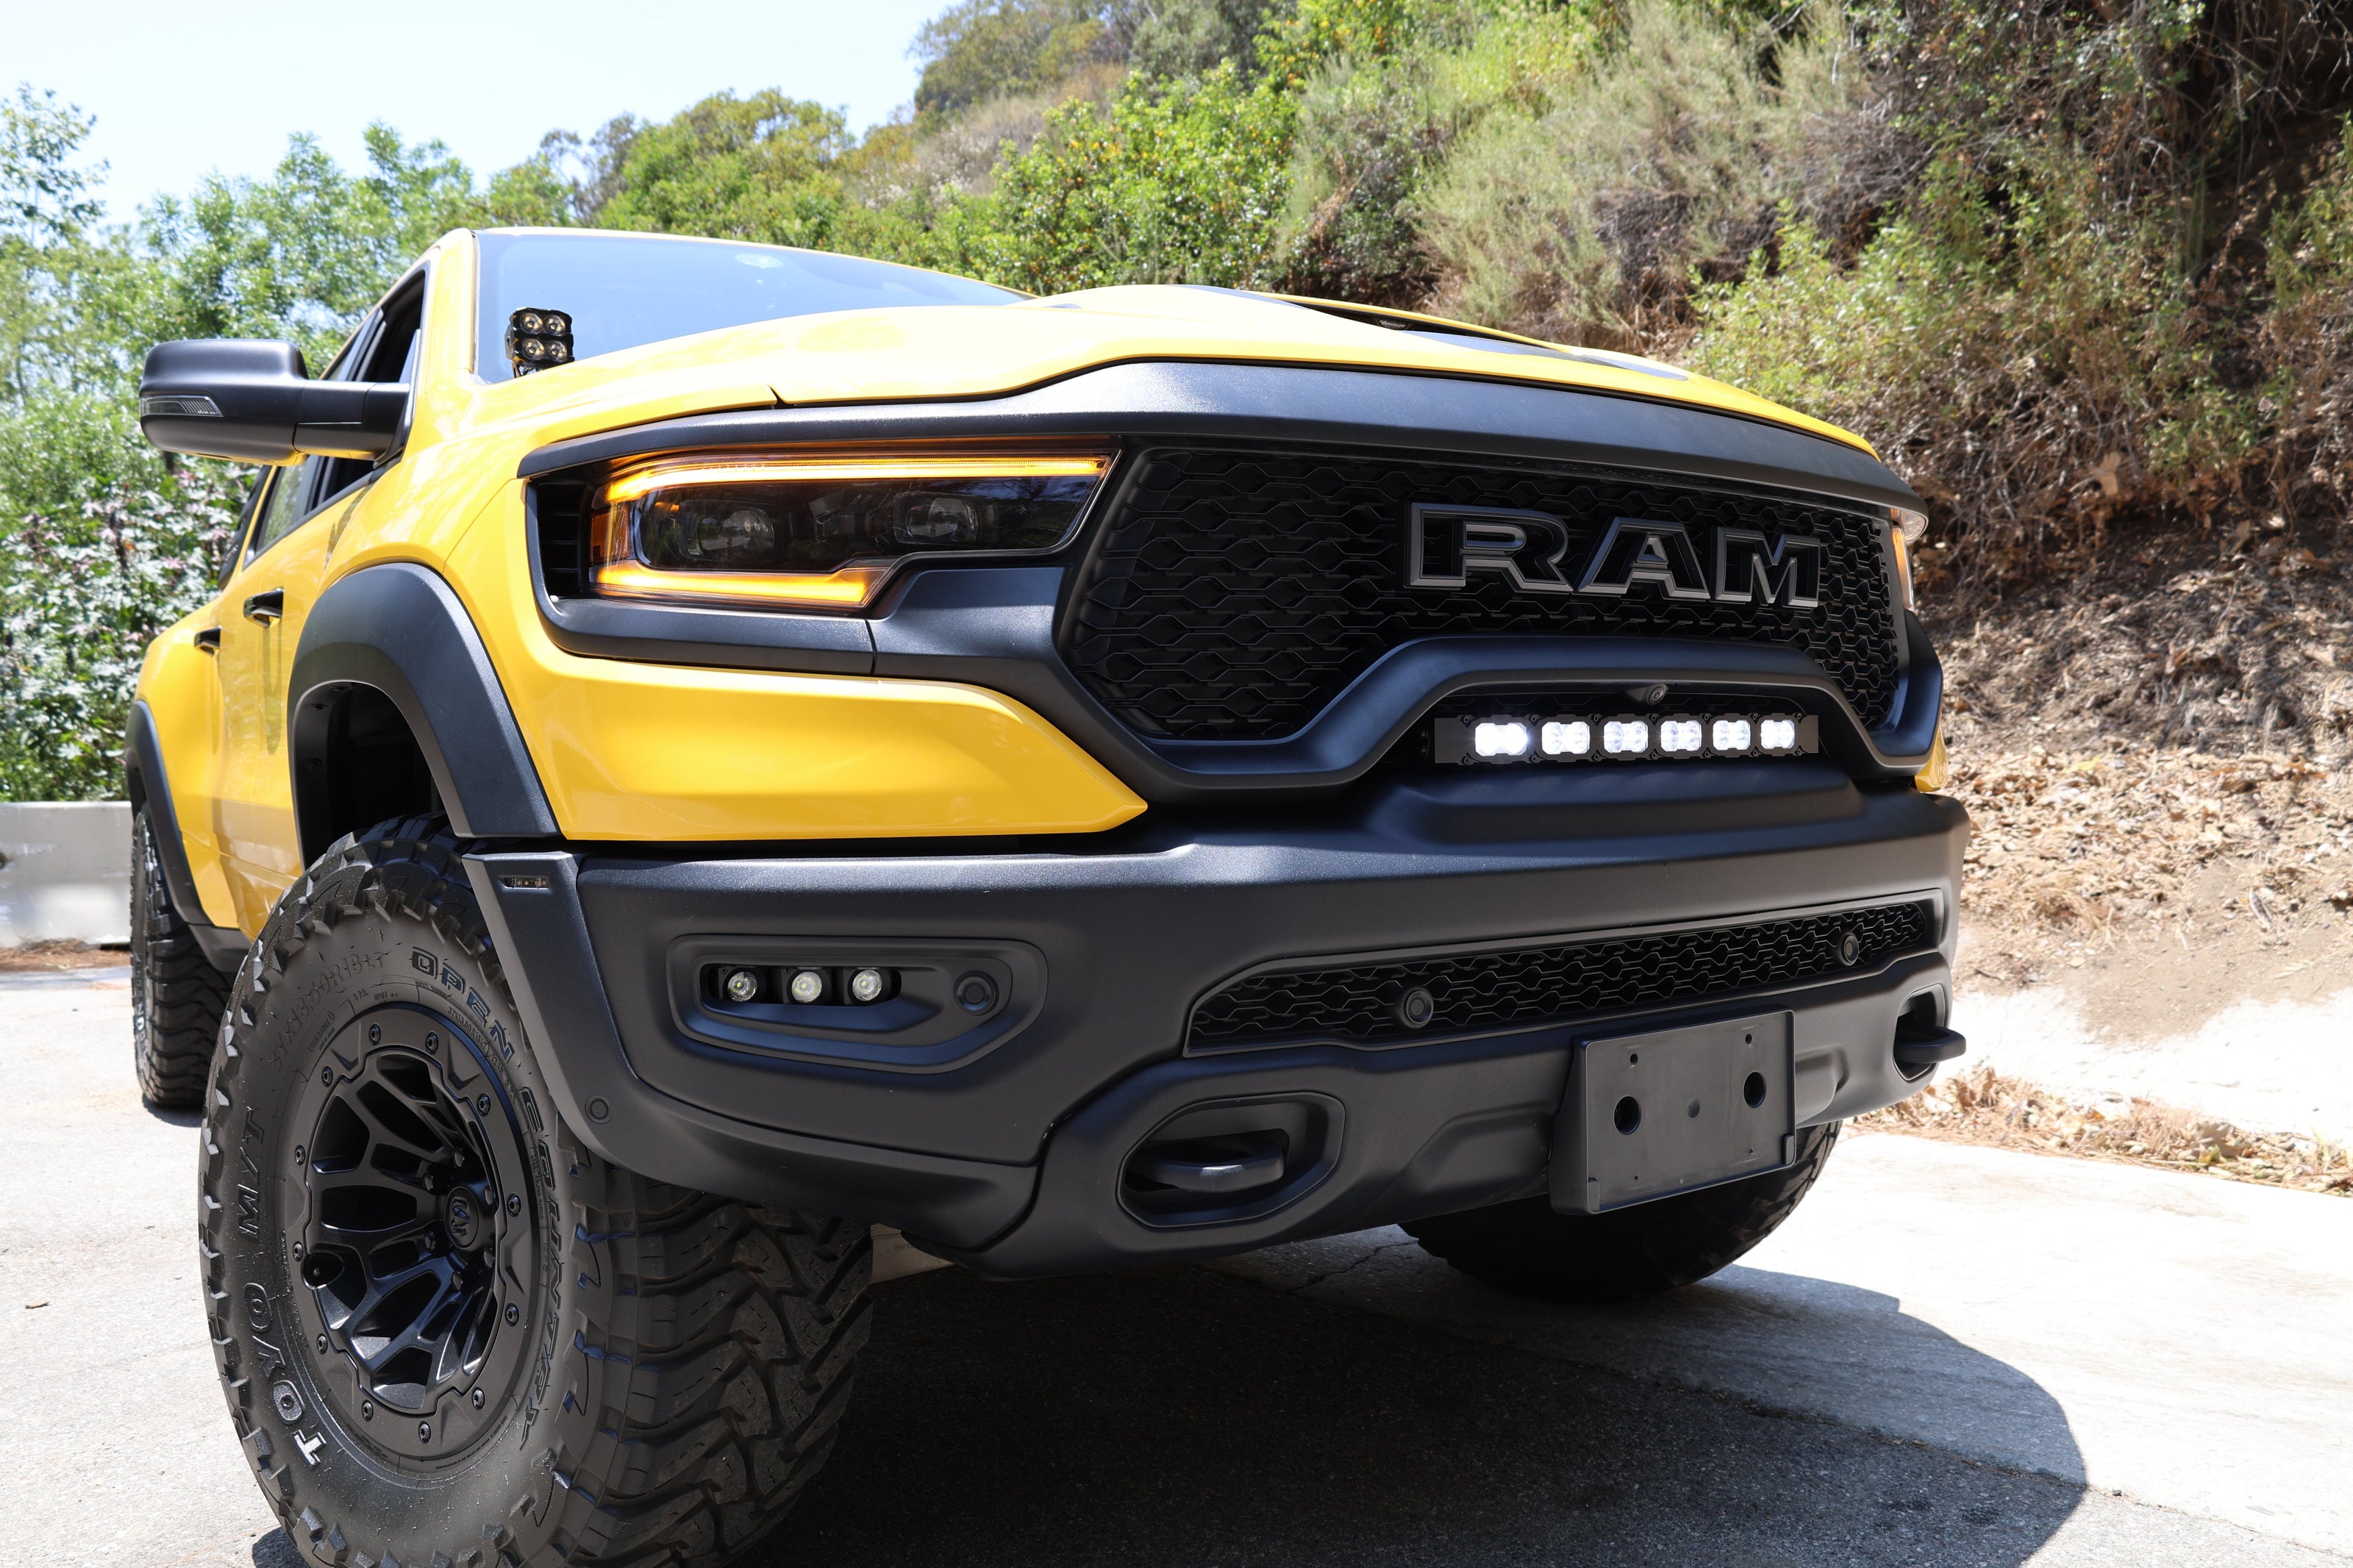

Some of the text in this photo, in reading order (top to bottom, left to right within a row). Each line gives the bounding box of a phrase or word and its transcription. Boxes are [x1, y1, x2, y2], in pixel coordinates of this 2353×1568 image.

[1403, 501, 1821, 609] RAM
[412, 946, 515, 1064] OPEN
[237, 1105, 265, 1239] M/T
[243, 1282, 326, 1469] TOYO
